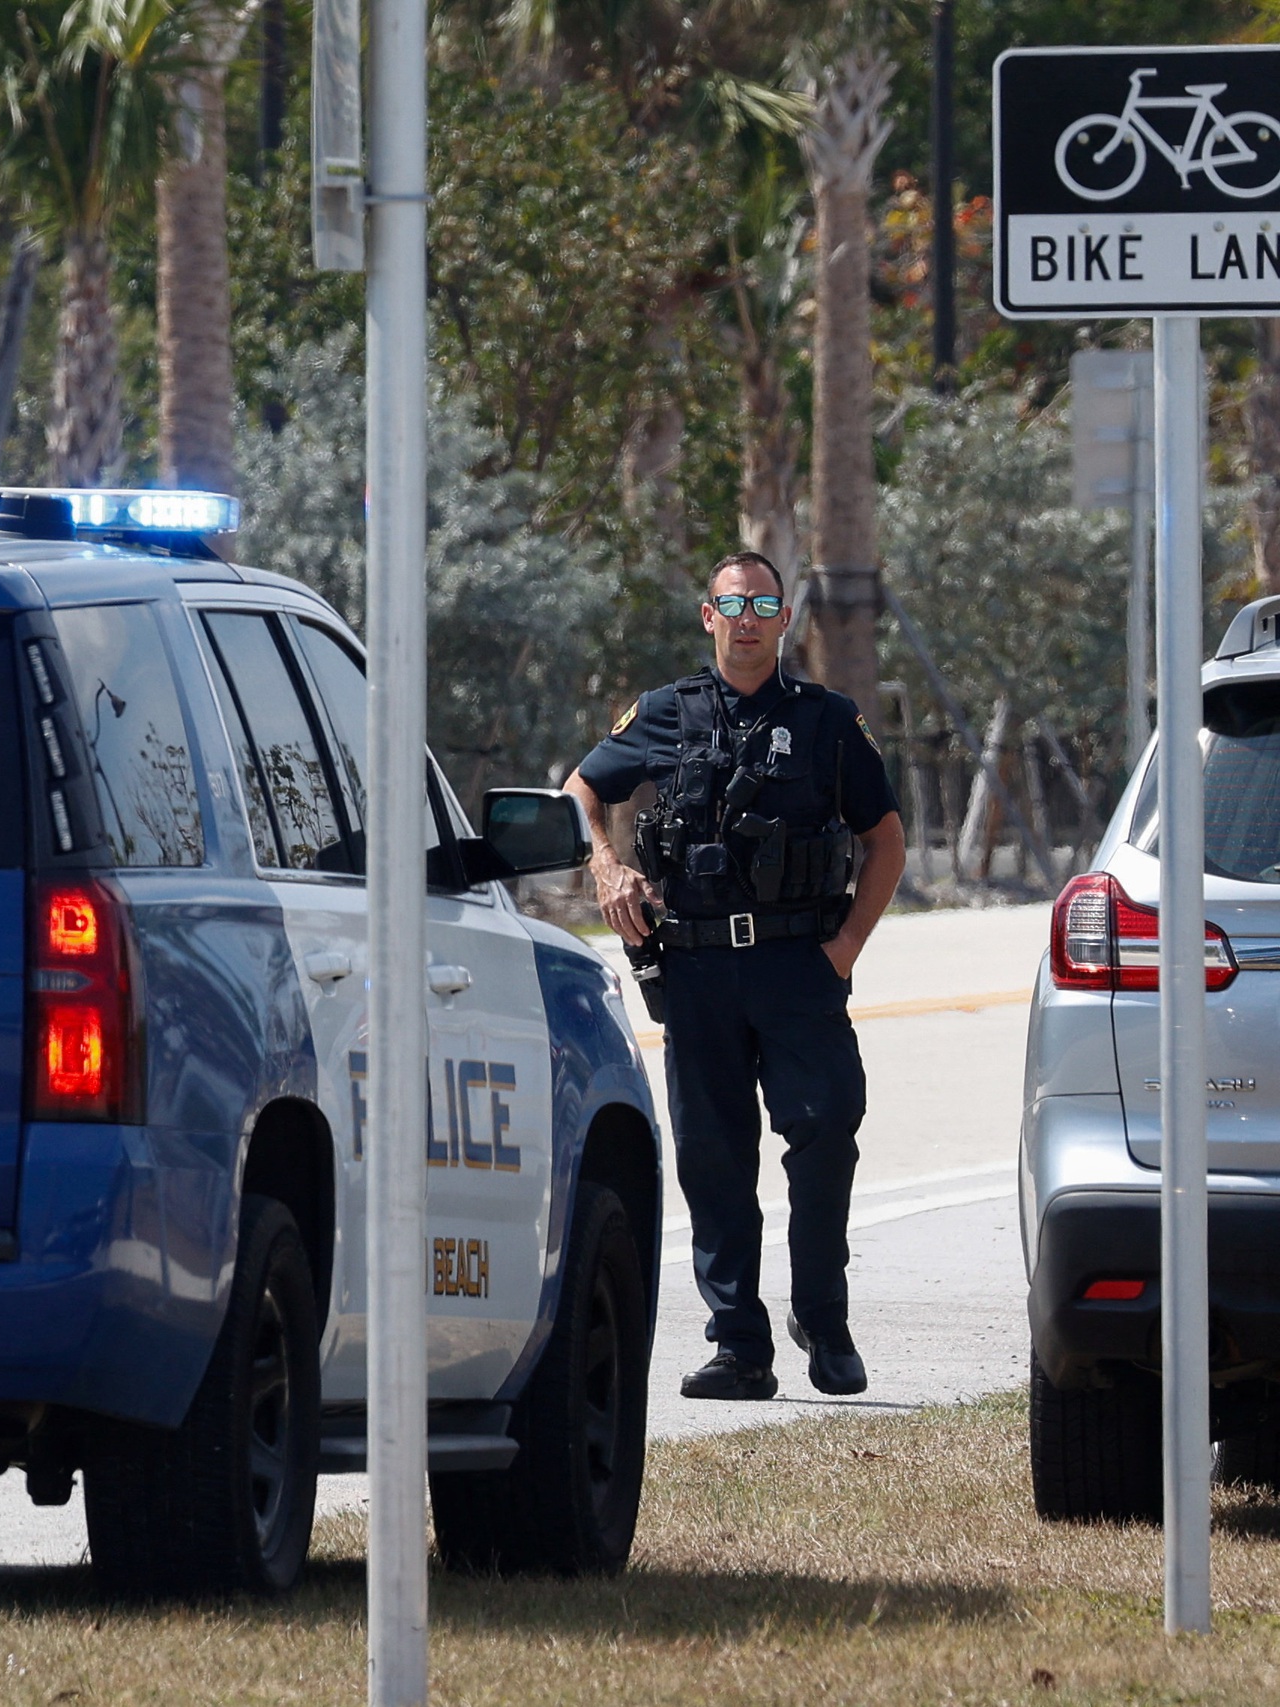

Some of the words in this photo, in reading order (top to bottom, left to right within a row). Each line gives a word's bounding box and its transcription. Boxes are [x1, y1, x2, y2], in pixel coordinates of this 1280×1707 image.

[1031, 235, 1143, 281] BIKE
[1190, 233, 1280, 280] LAN
[348, 1050, 521, 1173] PLICE
[1143, 1077, 1256, 1092] SARU
[433, 1237, 489, 1299] BEACH
